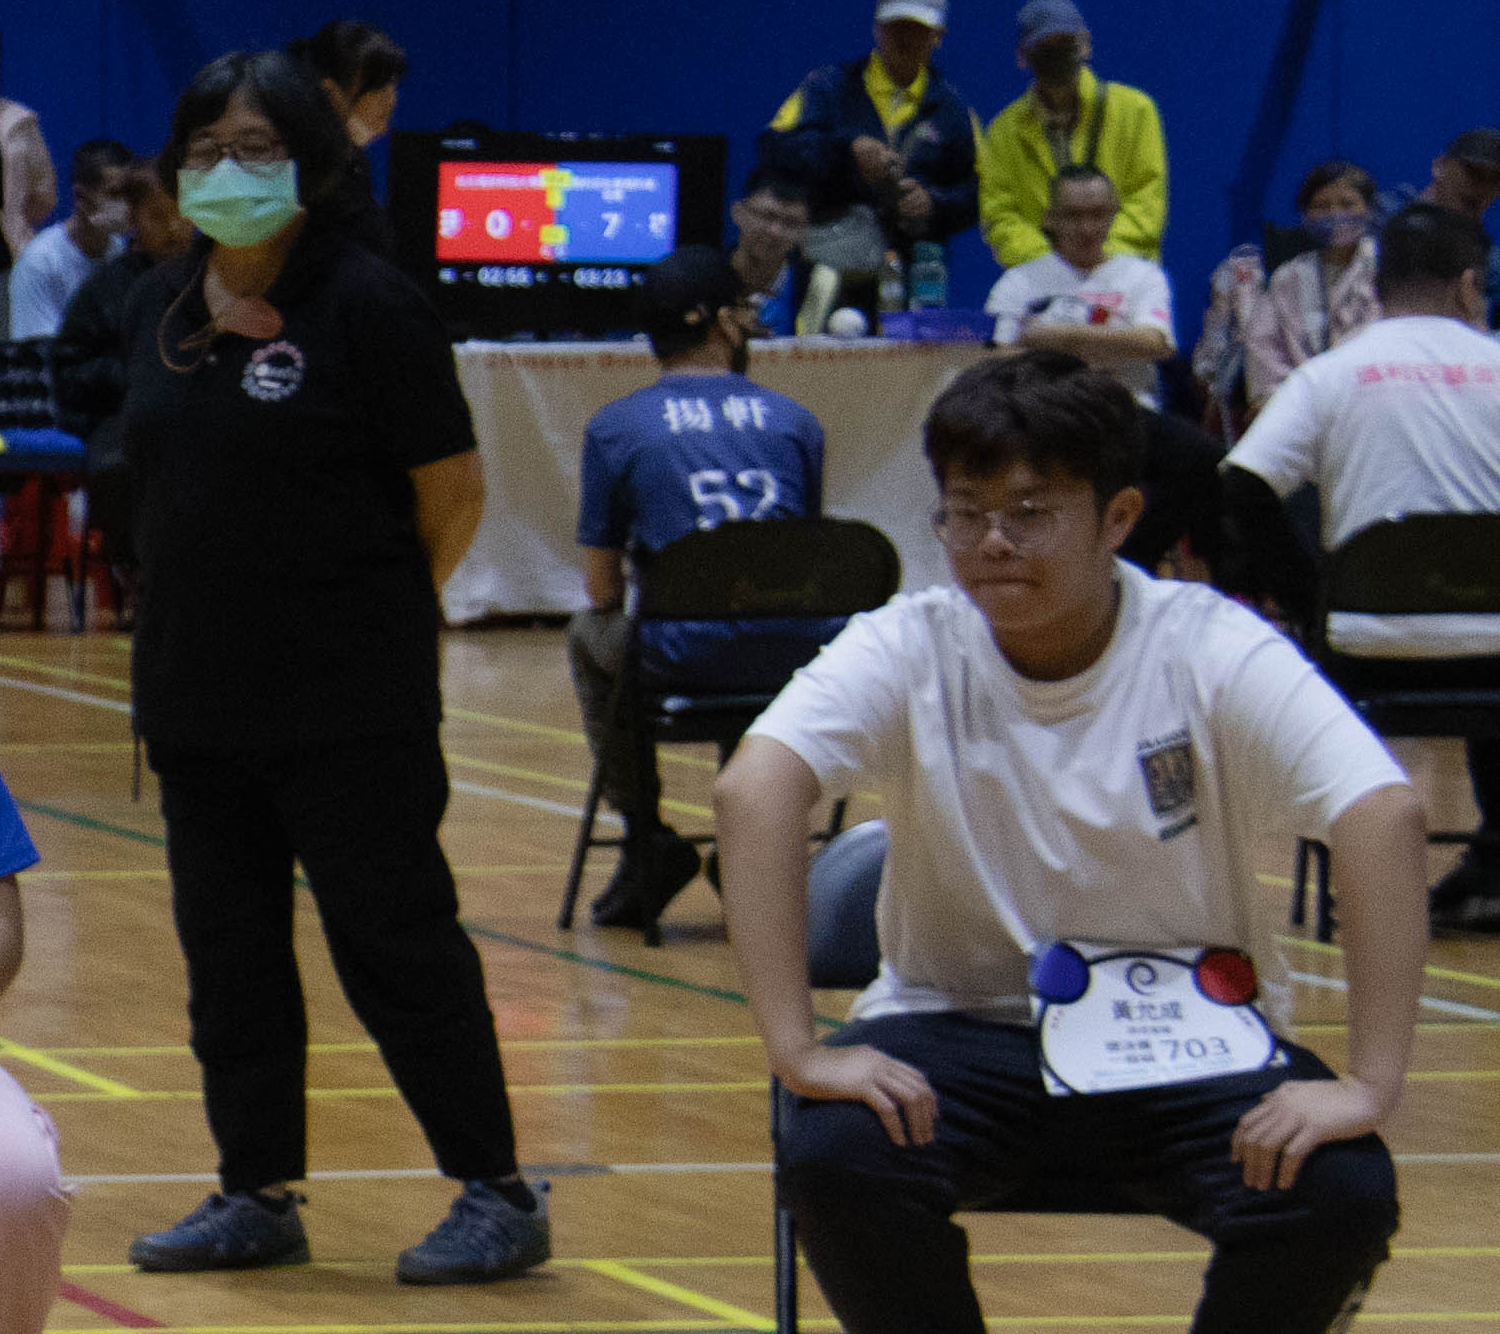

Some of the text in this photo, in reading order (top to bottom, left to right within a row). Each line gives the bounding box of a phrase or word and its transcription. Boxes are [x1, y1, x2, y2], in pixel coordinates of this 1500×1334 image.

[485, 209, 512, 240] 0
[601, 212, 624, 239] 7
[689, 469, 779, 531] 52
[1159, 1037, 1231, 1060] 703
